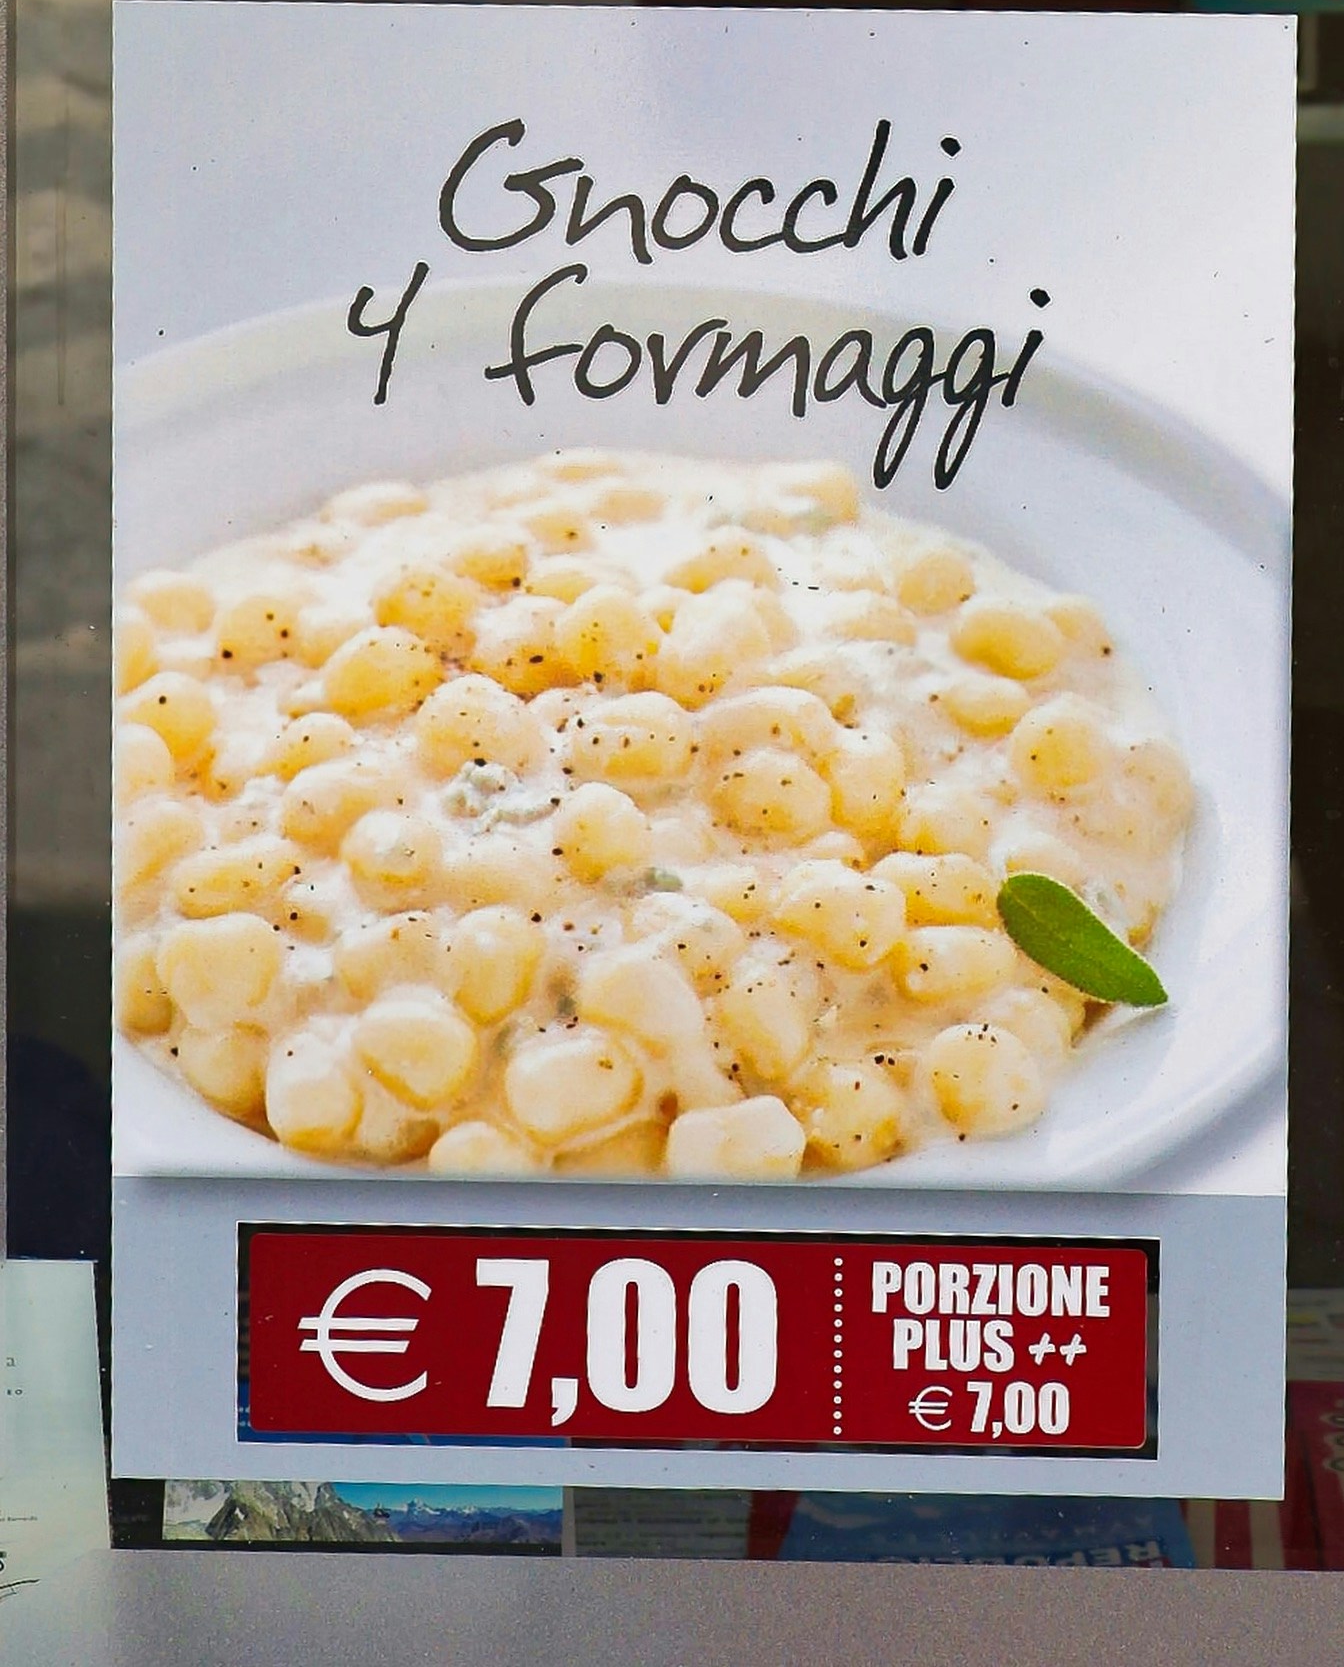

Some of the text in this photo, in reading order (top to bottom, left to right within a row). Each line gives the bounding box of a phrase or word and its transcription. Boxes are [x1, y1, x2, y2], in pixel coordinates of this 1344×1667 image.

[440, 119, 960, 264] Gnocchi
[348, 262, 1050, 489] 4 formaggi
[872, 1262, 1109, 1317] PORZIONE
[298, 1258, 777, 1426] € 7,00
[894, 1319, 1086, 1372] PLUS ++
[909, 1382, 1069, 1438] € 7,00
